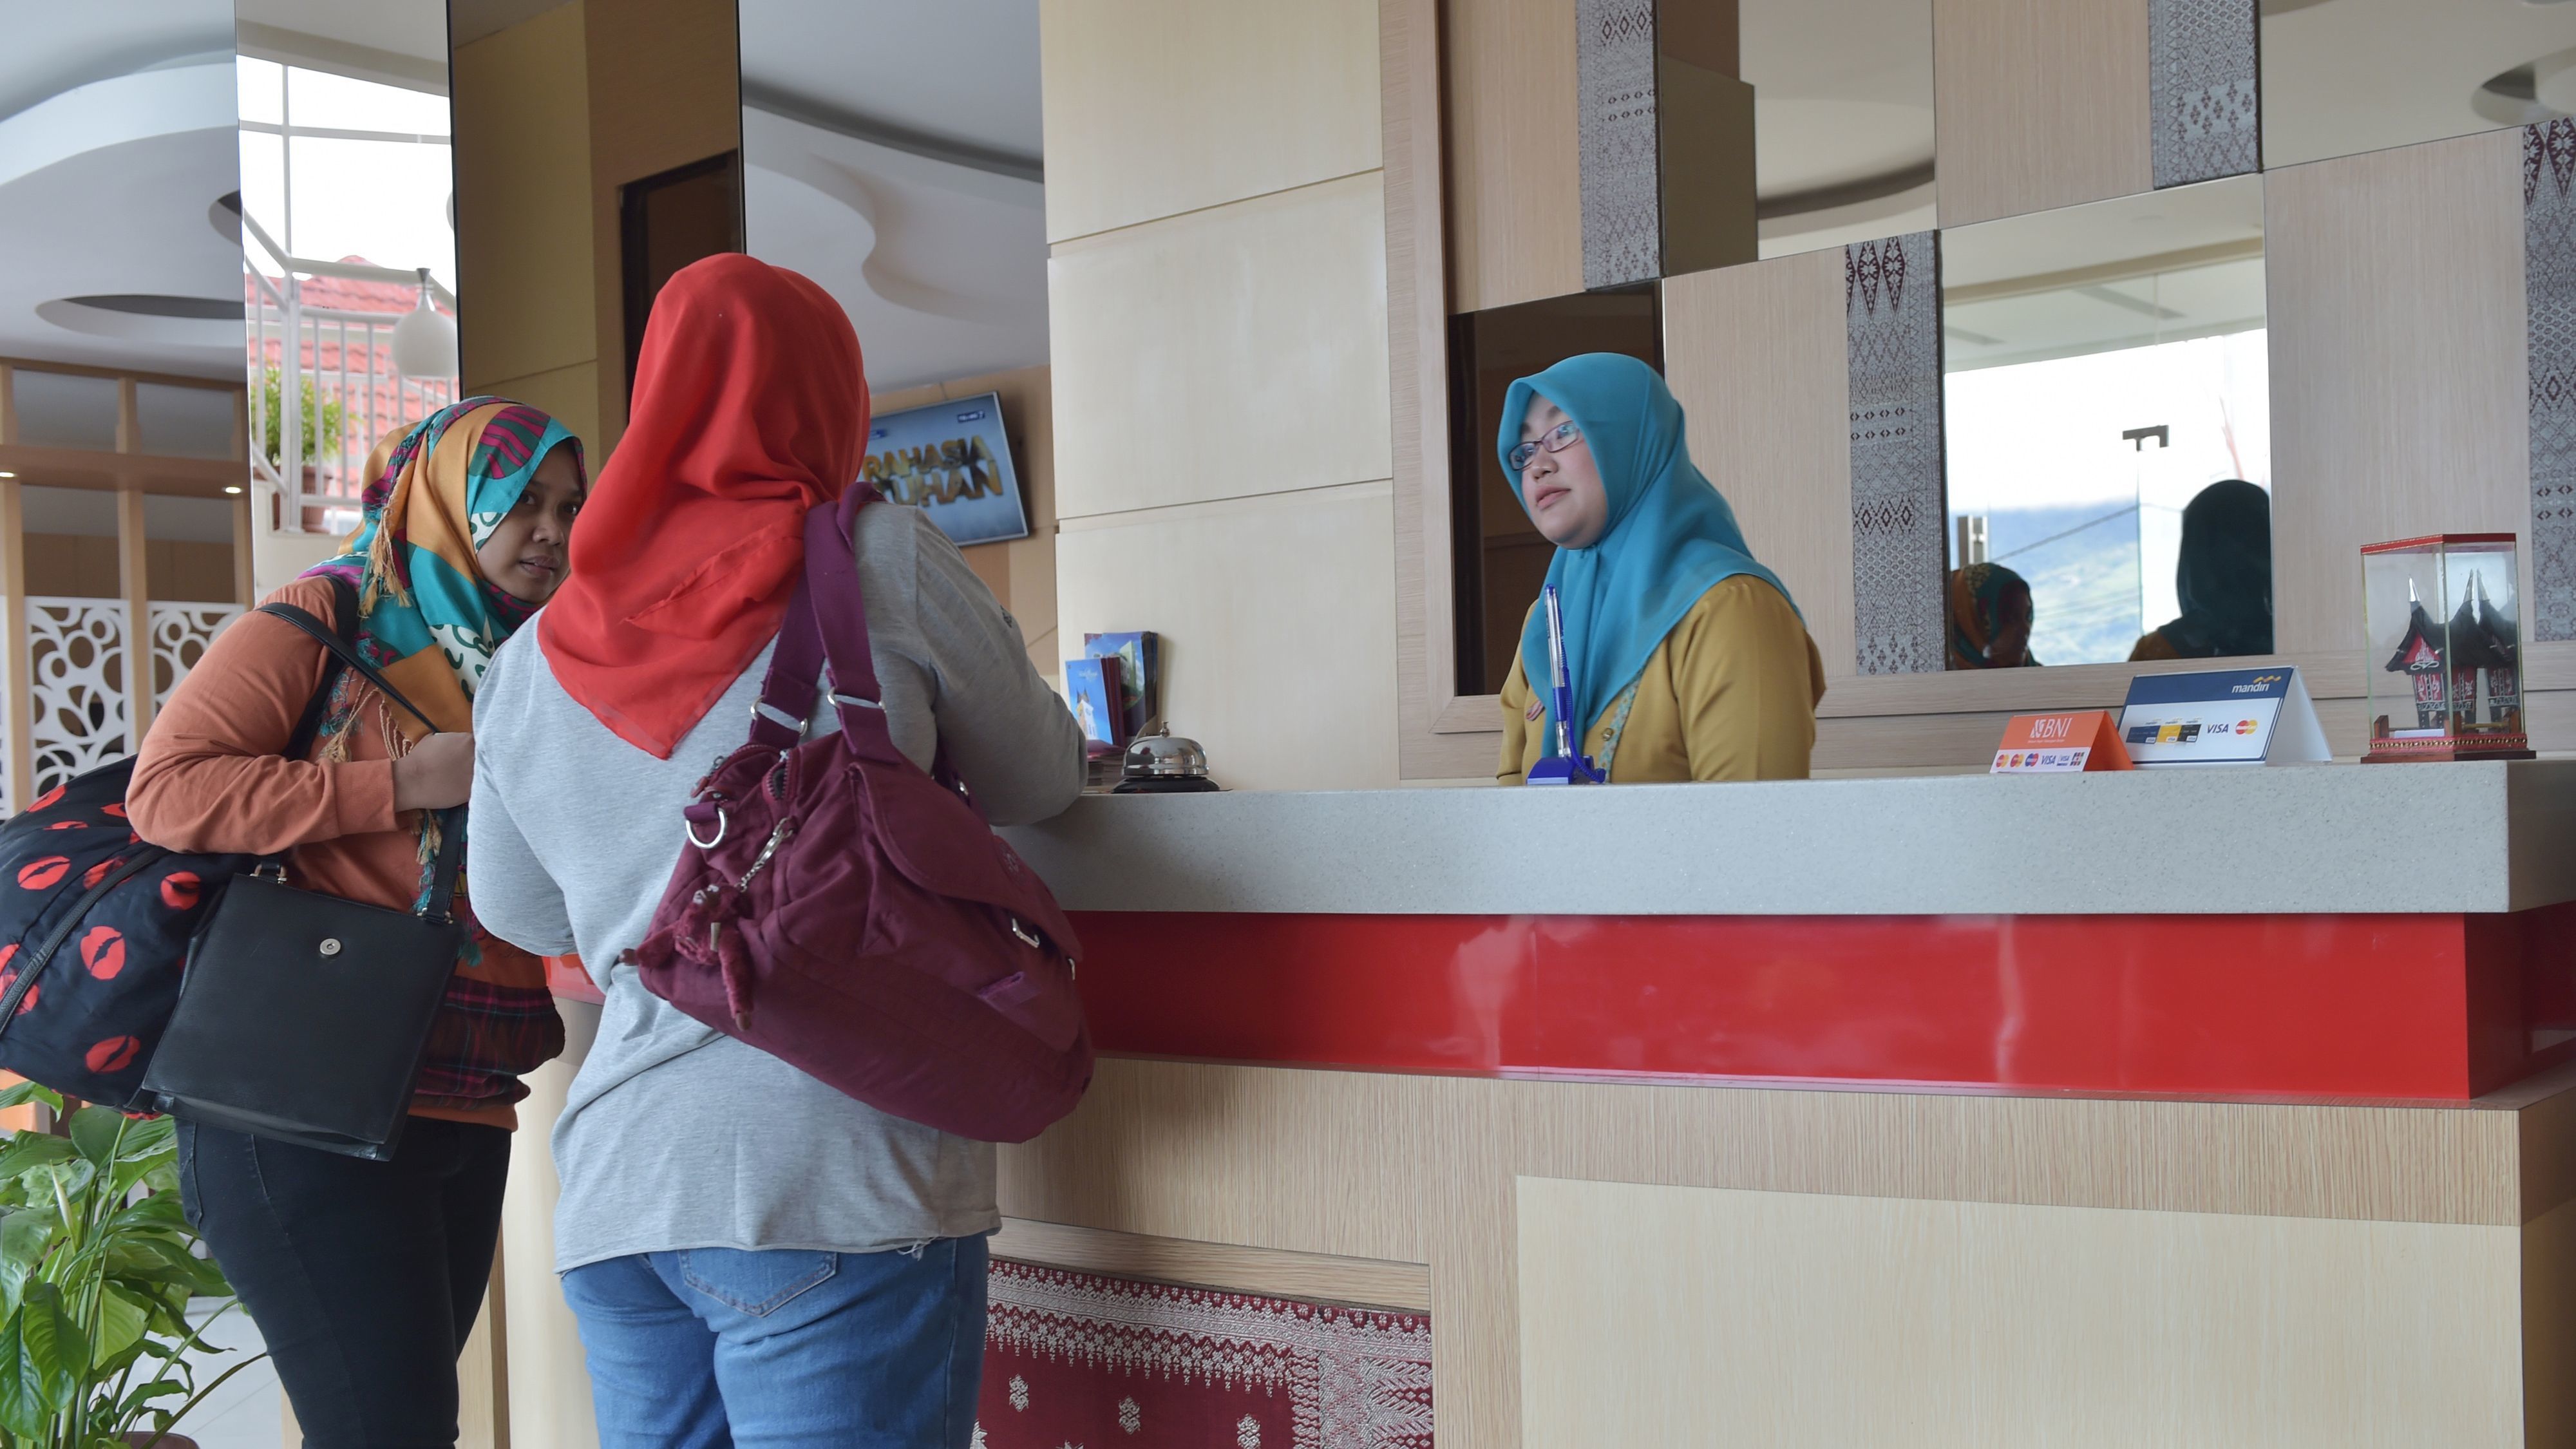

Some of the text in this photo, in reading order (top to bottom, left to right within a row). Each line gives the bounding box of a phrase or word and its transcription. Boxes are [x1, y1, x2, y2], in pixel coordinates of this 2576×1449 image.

[862, 435, 996, 482] RAHASIA
[2231, 682, 2269, 694] mandiri
[2042, 717, 2072, 739] BNI
[2207, 723, 2230, 734] VISA
[2041, 755, 2056, 765] VISA
